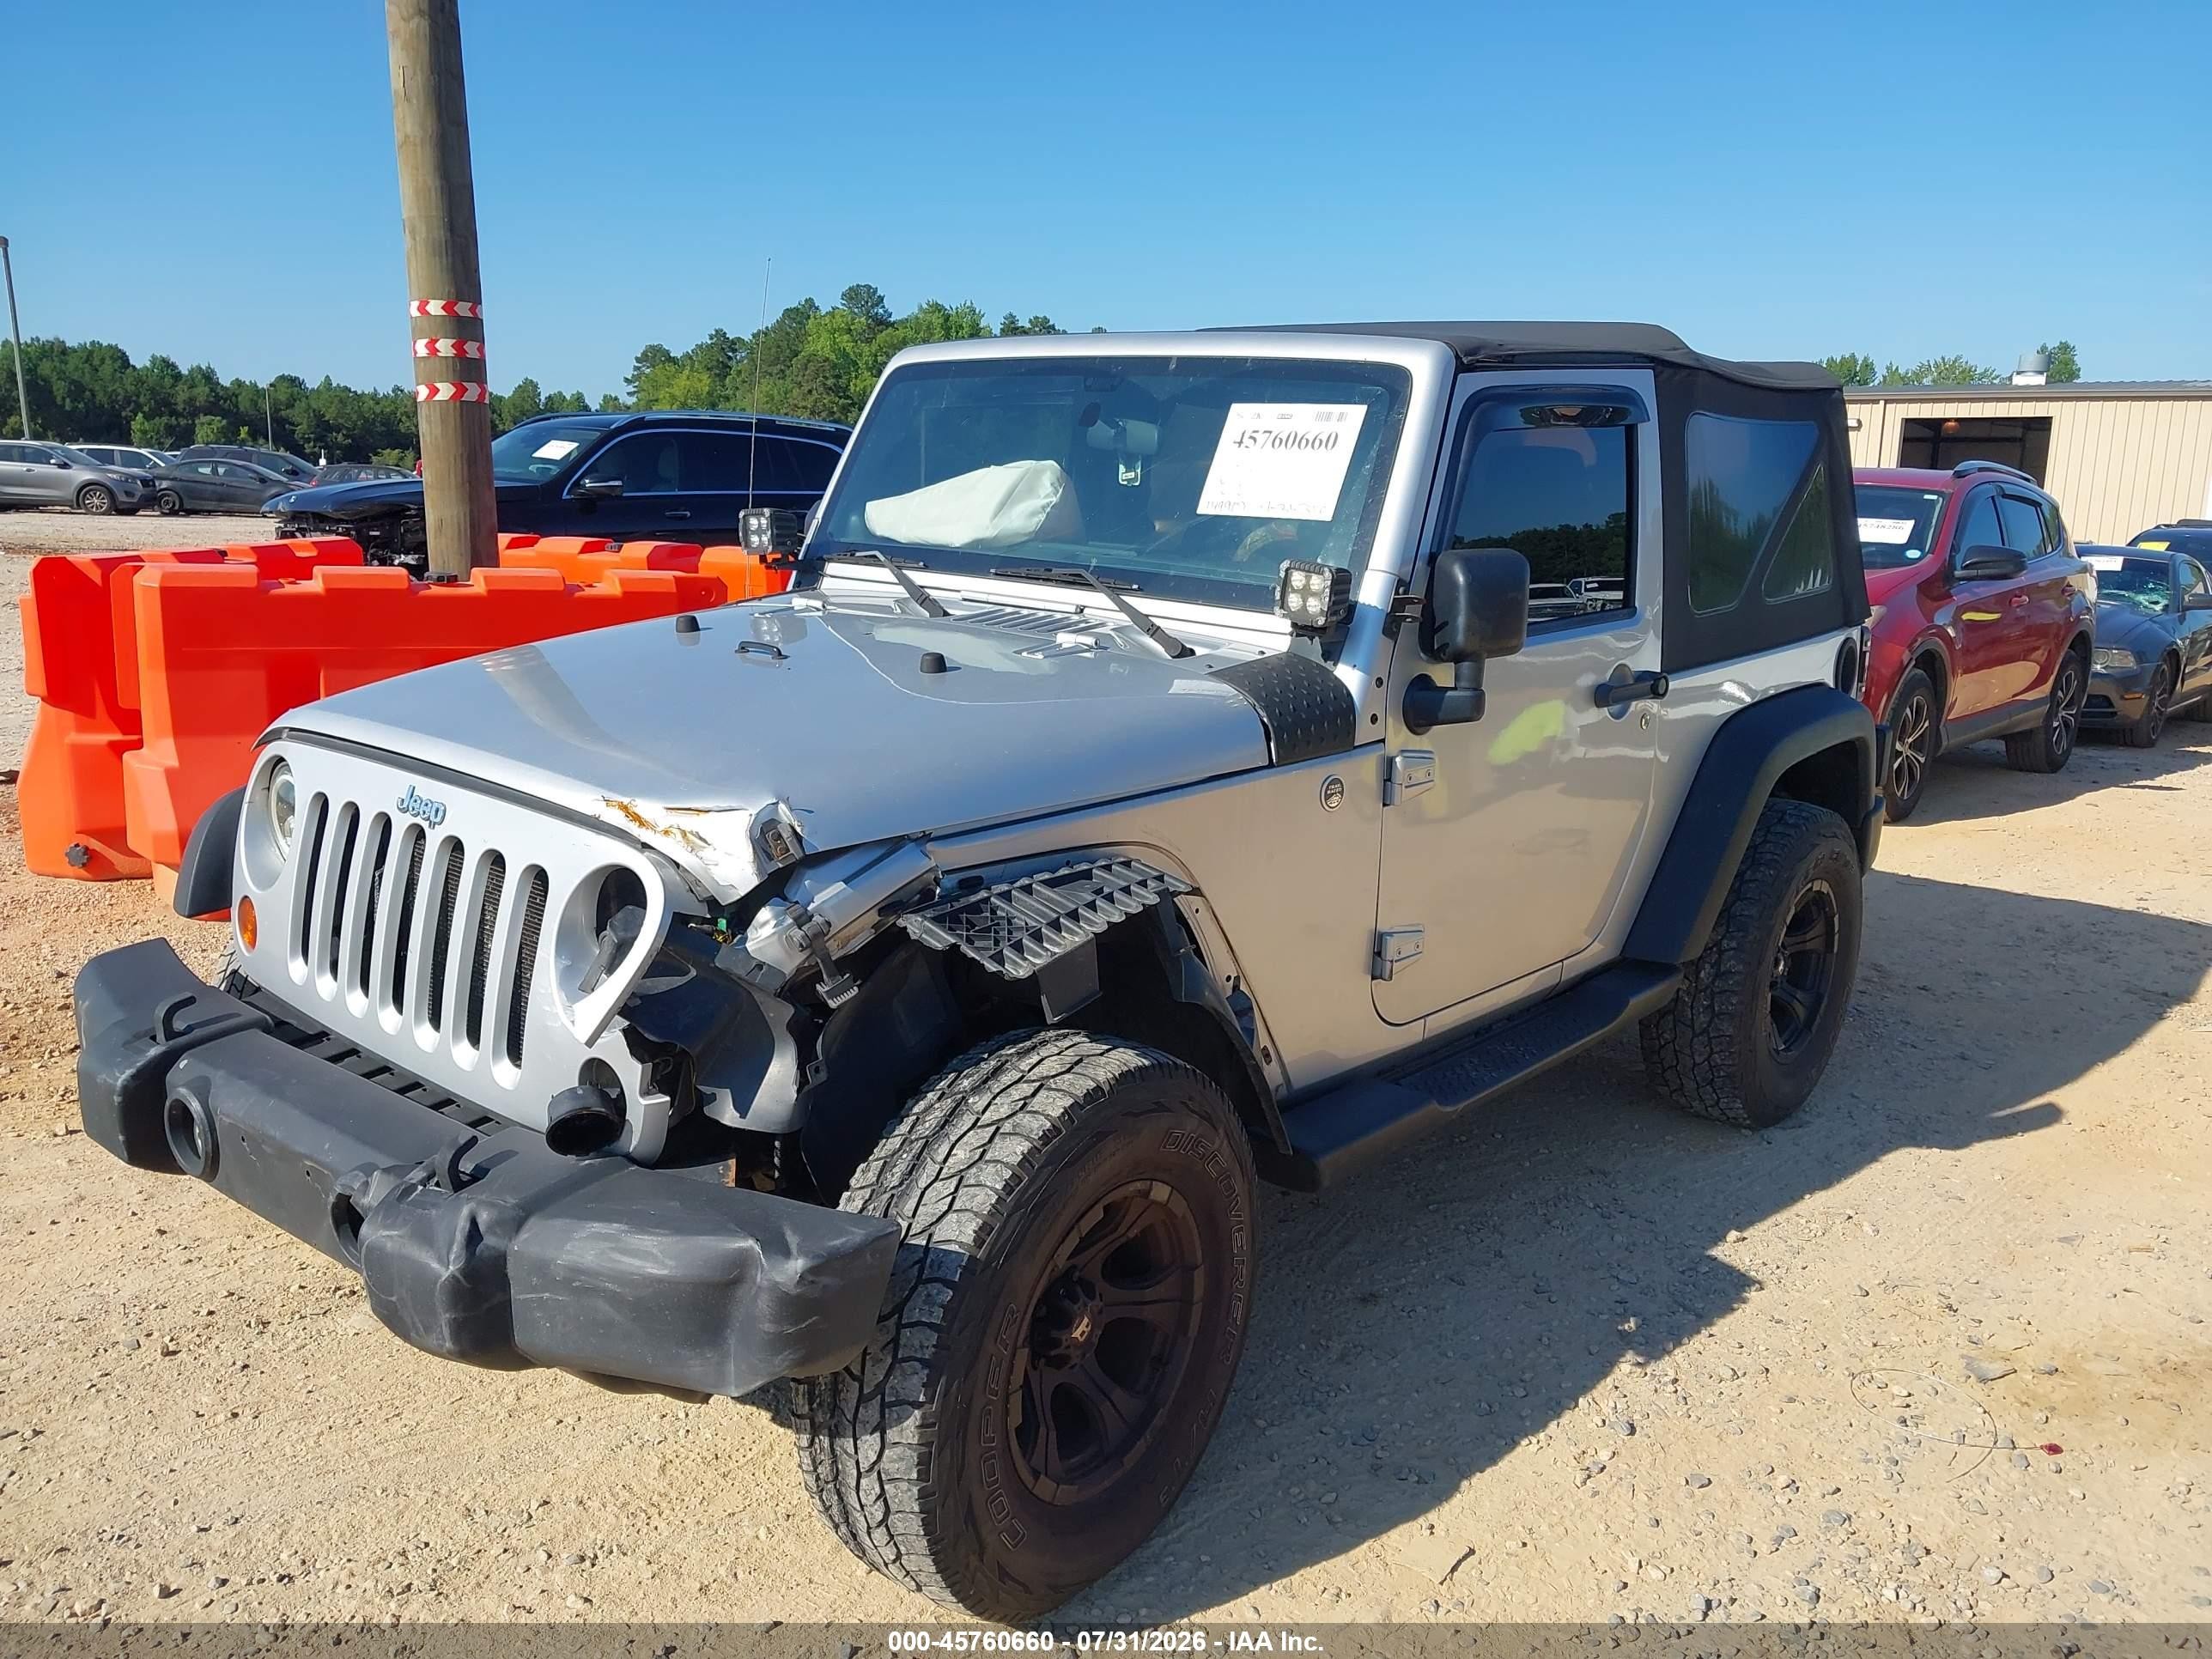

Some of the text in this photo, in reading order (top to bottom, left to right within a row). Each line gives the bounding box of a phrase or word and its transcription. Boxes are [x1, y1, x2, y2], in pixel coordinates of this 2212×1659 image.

[1233, 429, 1339, 451] 45760660
[397, 785, 447, 830] Jeep
[1160, 1129, 1247, 1365] DISCOVERER
[980, 1304, 1027, 1551] COOPER
